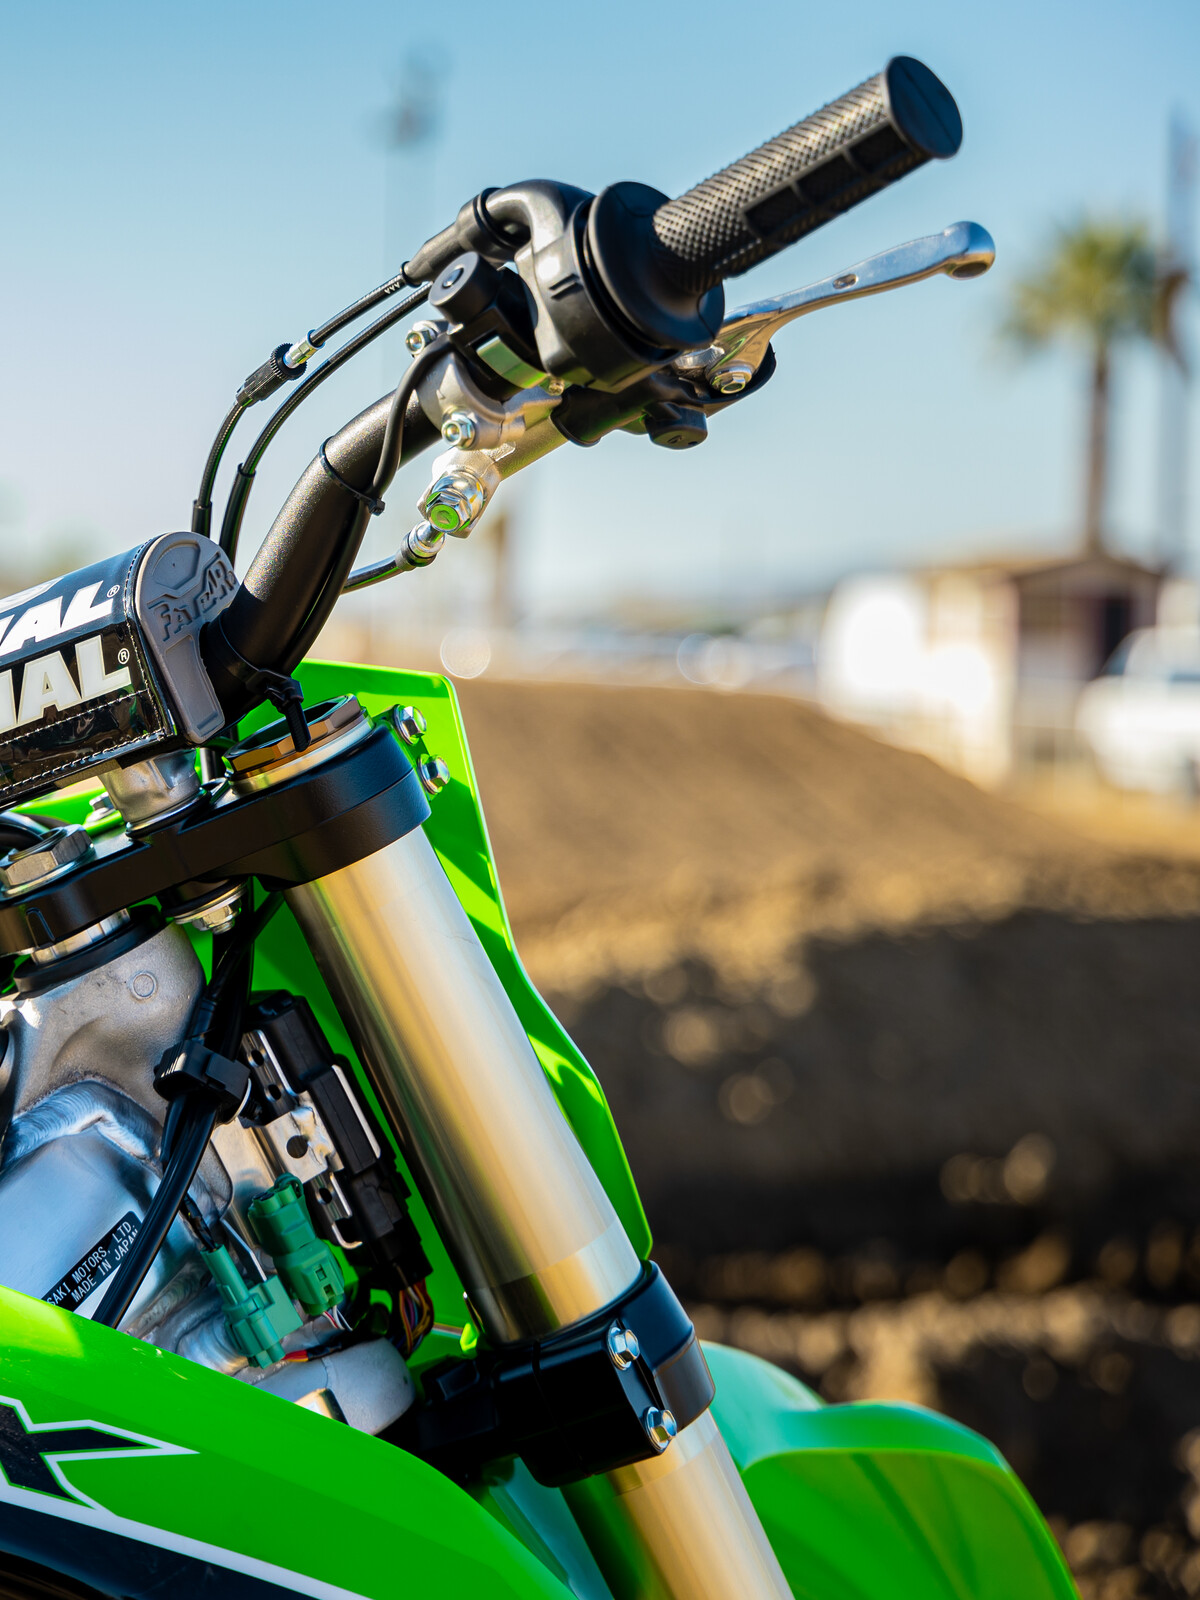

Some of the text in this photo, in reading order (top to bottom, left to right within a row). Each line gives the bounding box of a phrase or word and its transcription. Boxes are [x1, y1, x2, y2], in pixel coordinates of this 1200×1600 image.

[112, 1221, 136, 1243] LTD.
[70, 1274, 97, 1303] MADE
[97, 1259, 112, 1276] IN
